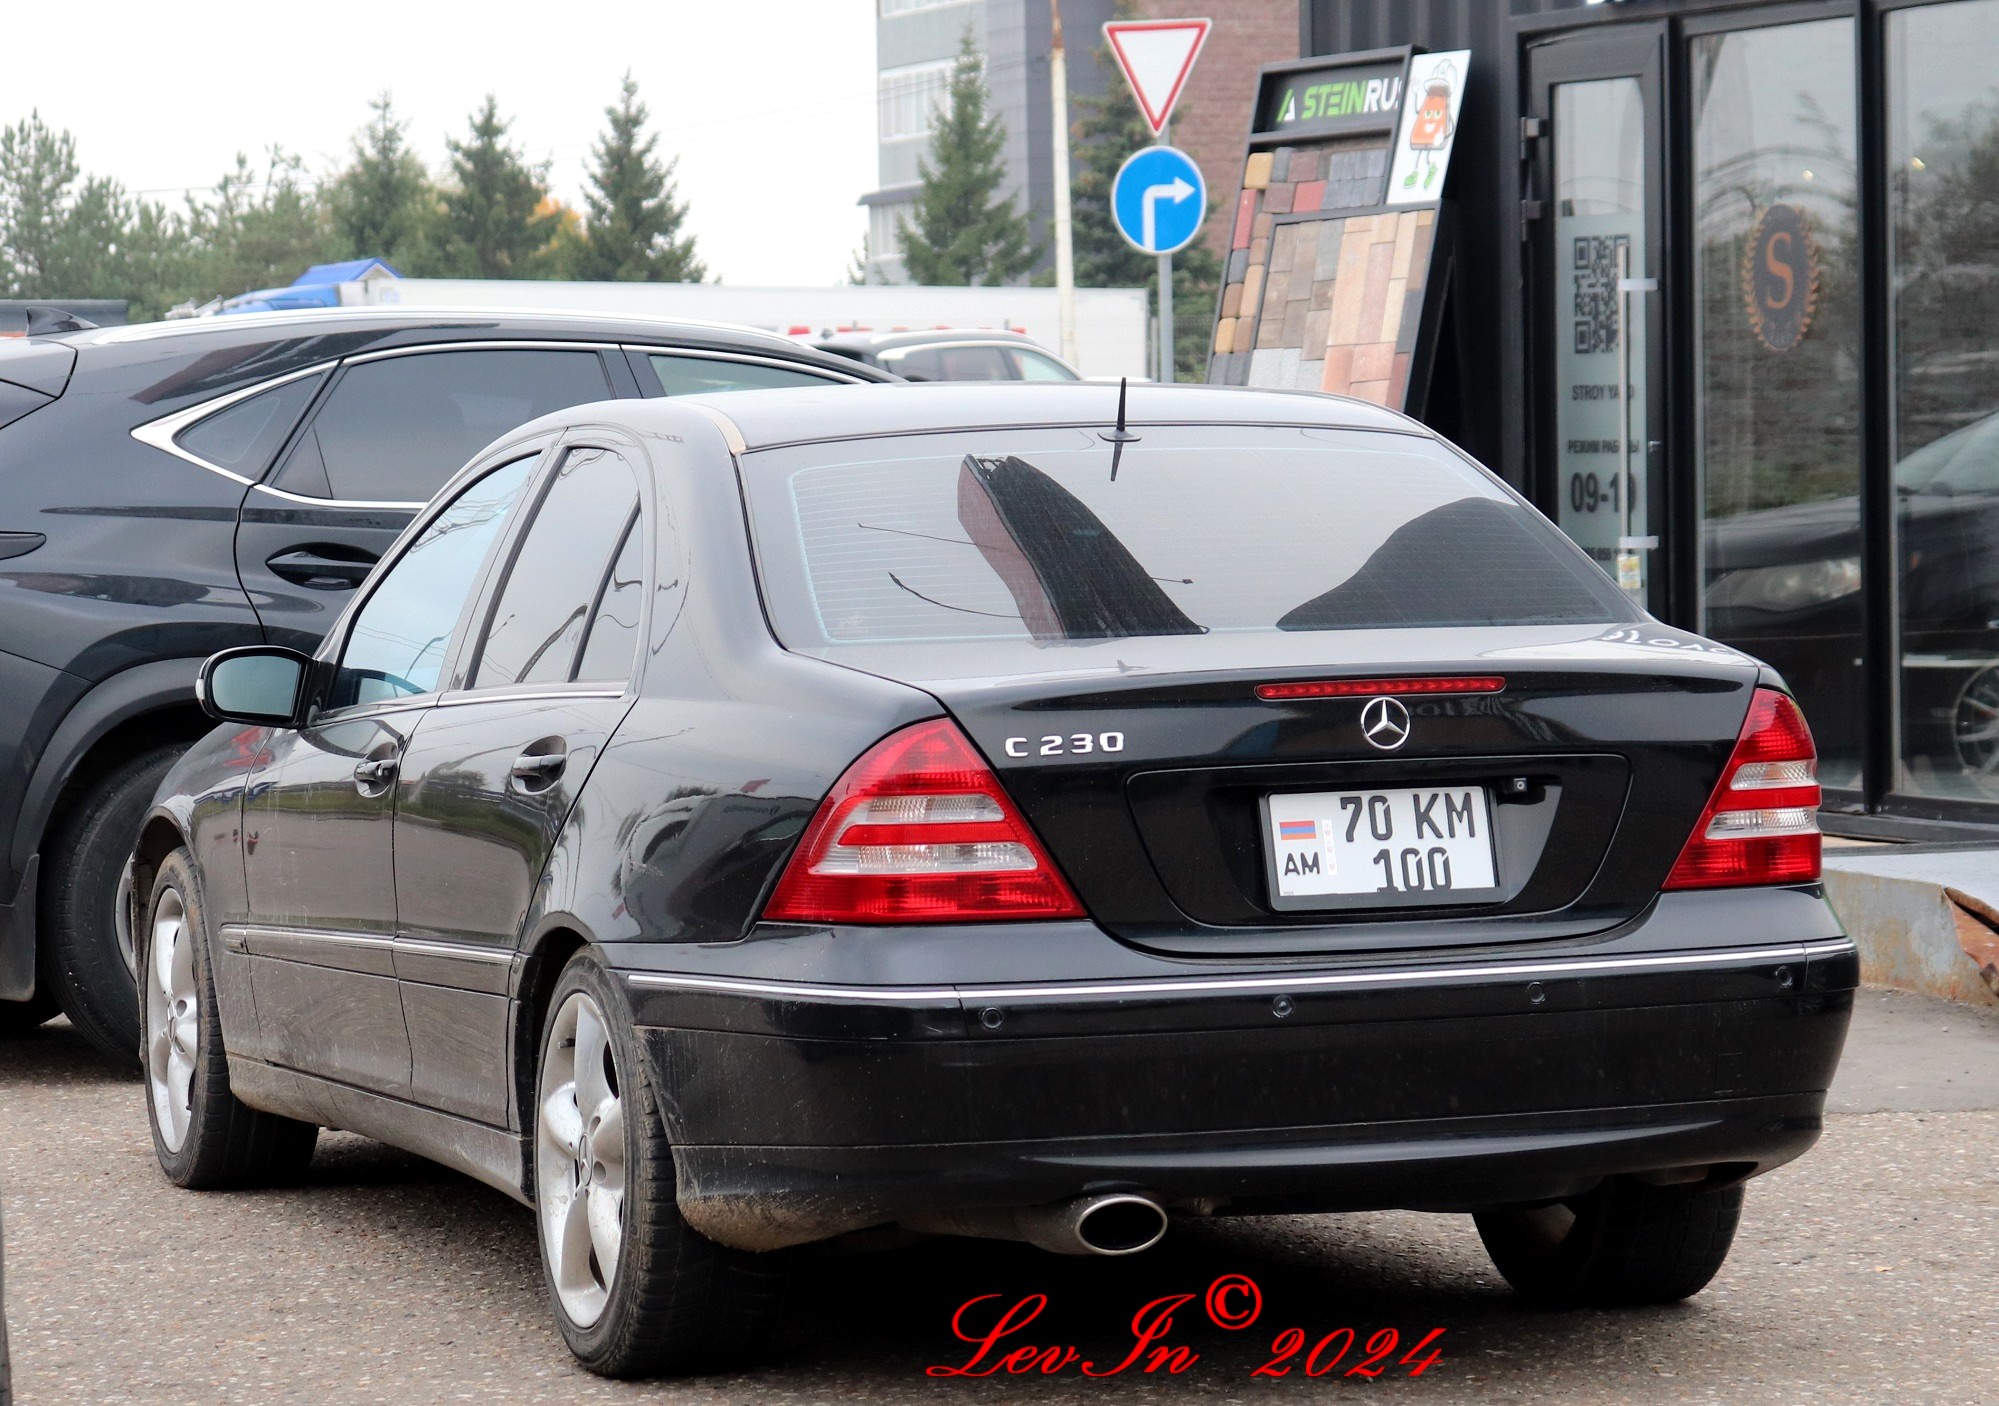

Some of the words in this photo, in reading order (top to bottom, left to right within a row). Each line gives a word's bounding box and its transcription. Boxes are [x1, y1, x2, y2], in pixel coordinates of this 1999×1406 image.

[1302, 77, 1401, 120] STEINRU
[1766, 232, 1794, 309] S
[1005, 737, 1029, 758] C
[1040, 732, 1124, 756] 230
[1340, 795, 1393, 842] 70
[1413, 792, 1476, 839] KM
[1284, 852, 1321, 876] AM
[1373, 847, 1452, 891] 100
